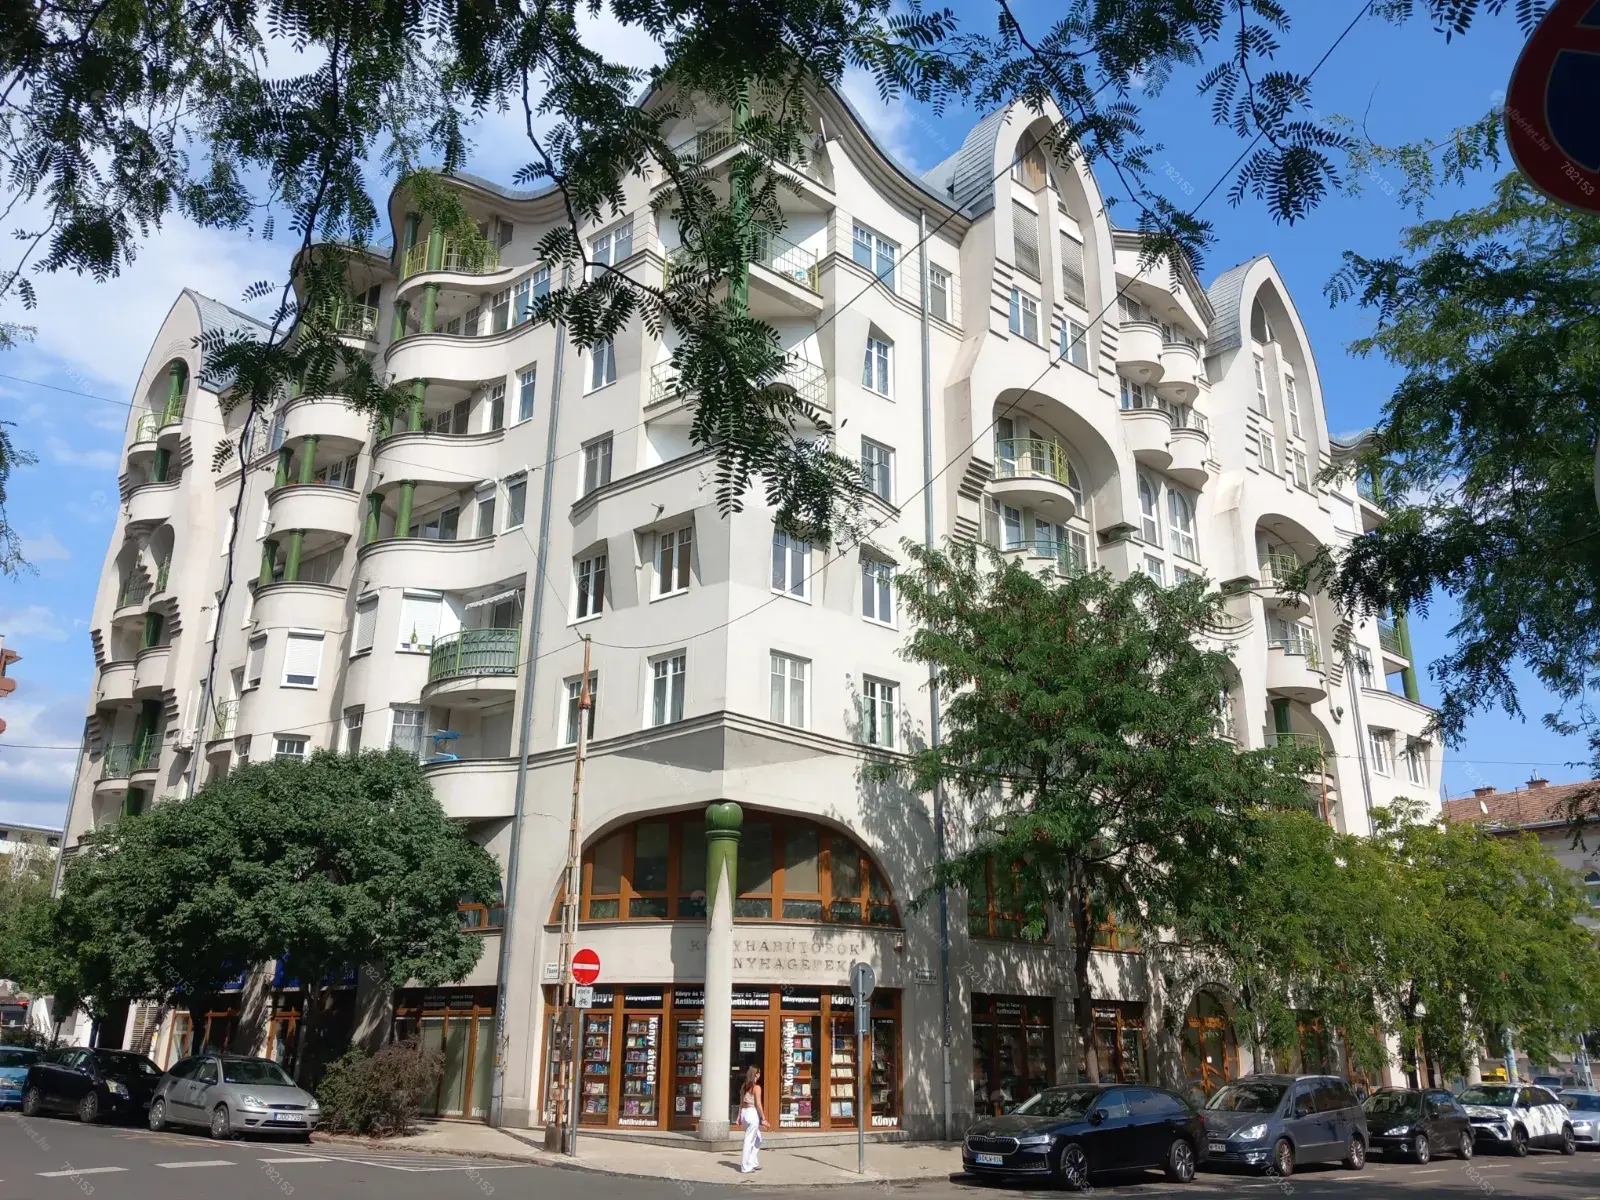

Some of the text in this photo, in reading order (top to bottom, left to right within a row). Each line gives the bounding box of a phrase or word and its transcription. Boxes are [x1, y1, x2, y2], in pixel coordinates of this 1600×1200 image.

[592, 991, 613, 1003] önyv
[731, 998, 769, 1006] ntikvárium
[646, 1017, 658, 1085] Könyv átvétel
[618, 1117, 658, 1127] Antikvárium
[780, 1120, 820, 1128] Antikvárium
[871, 1115, 899, 1127] Könyv
